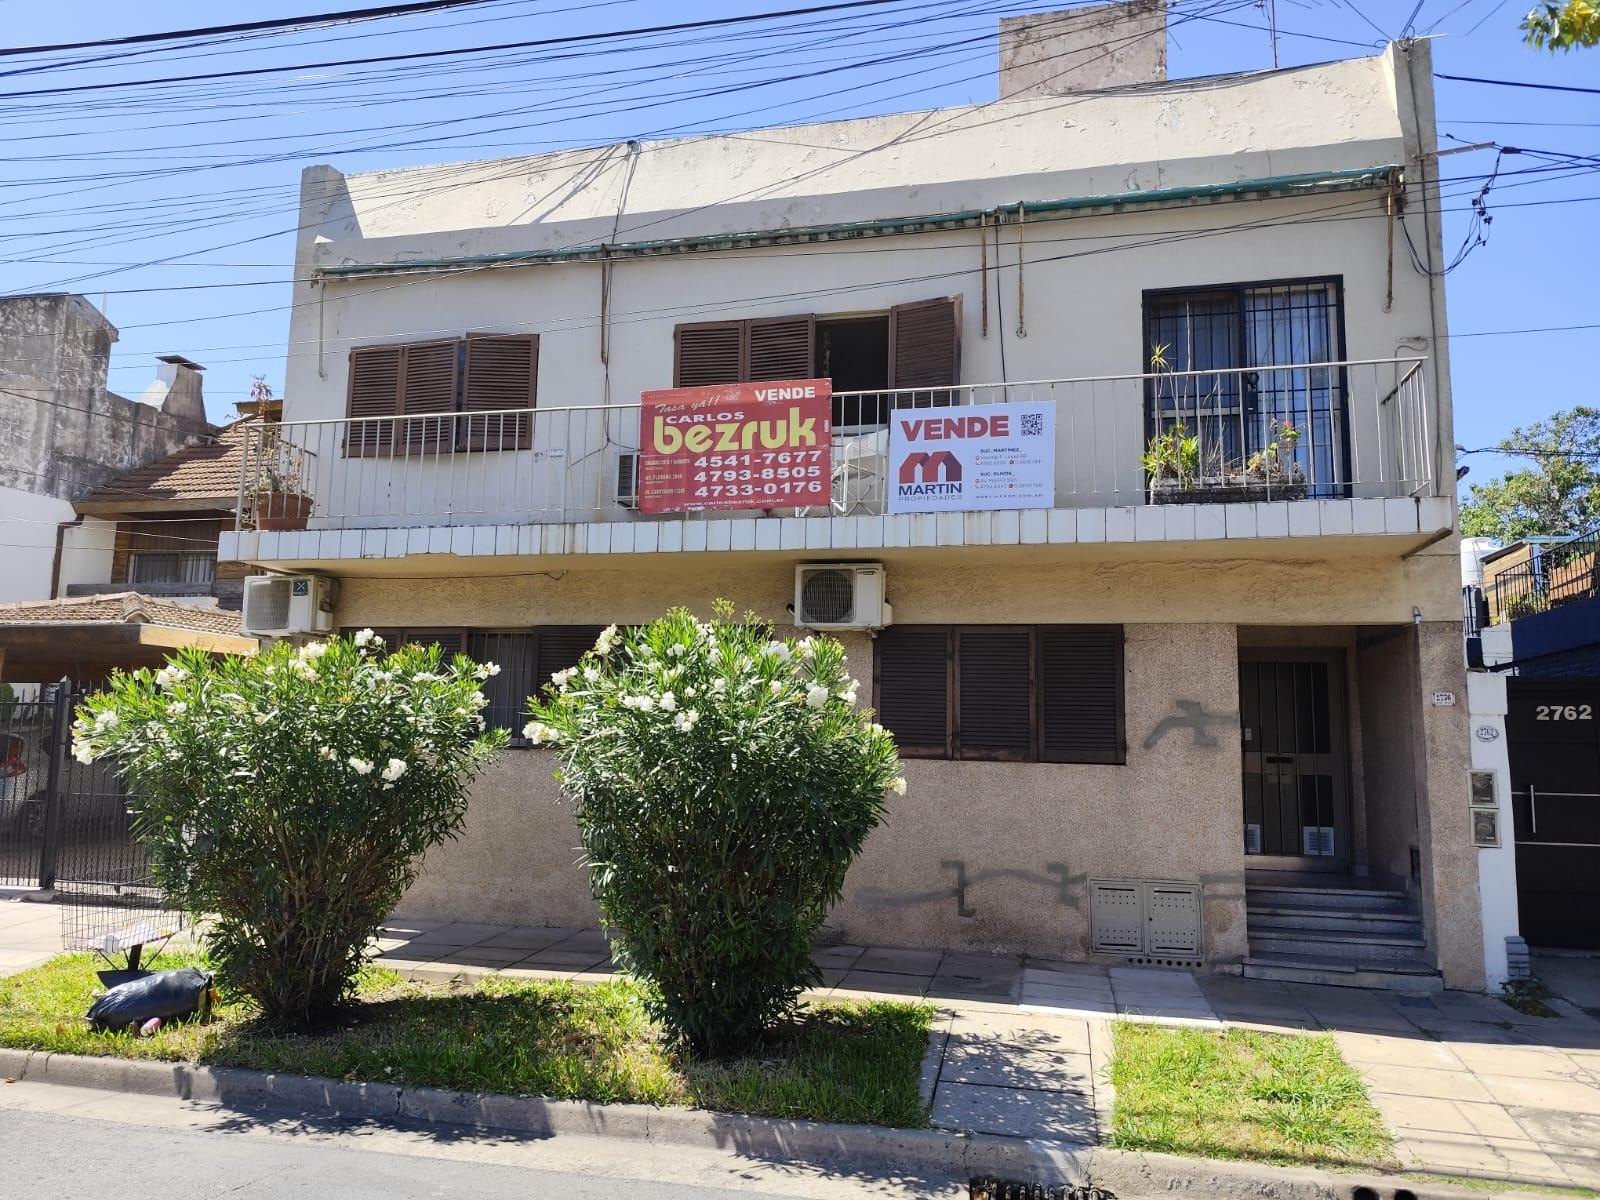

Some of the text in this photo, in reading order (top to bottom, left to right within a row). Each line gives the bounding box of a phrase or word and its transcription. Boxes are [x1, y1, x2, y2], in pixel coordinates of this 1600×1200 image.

[754, 386, 816, 402] VENDE
[655, 403, 685, 414] Tasa
[665, 411, 745, 424] CARLOS
[653, 407, 817, 455] bezruk
[900, 415, 1010, 442] VENDE
[694, 450, 823, 468] 4541-7677
[693, 465, 821, 483] 4793-8505
[694, 480, 822, 498] 4733-0176
[898, 482, 962, 496] MARTIN
[1536, 704, 1592, 721] 2762
